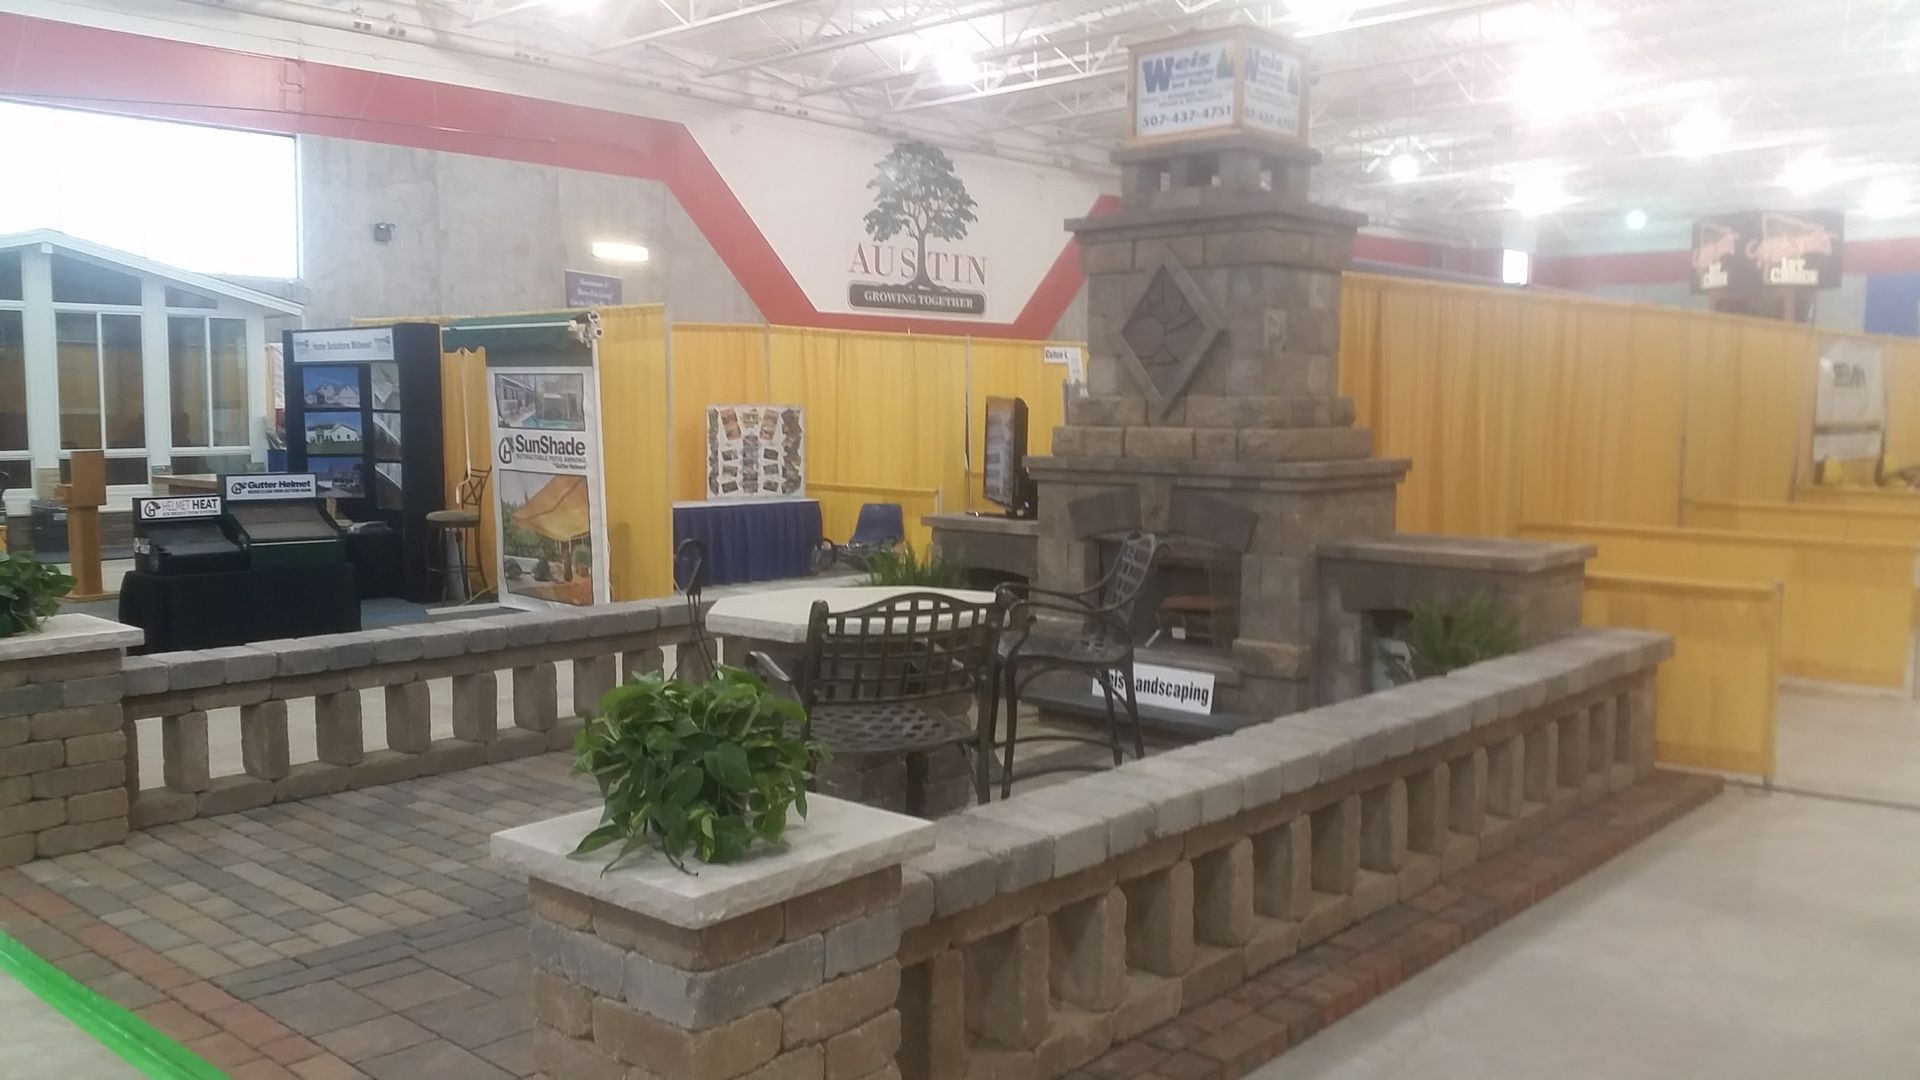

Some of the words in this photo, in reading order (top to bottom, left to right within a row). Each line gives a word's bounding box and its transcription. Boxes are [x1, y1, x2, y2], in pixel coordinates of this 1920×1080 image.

[1142, 51, 1212, 93] Weis
[848, 243, 988, 285] AUSTIN
[864, 290, 916, 304] GROWING
[918, 294, 974, 308] TOGETHER
[515, 434, 586, 456] SunShade
[247, 481, 278, 489] Gutter
[279, 480, 311, 488] Helmet
[162, 500, 191, 511] HELMET
[192, 499, 218, 510] HEAT
[1135, 676, 1209, 707] andscaping
